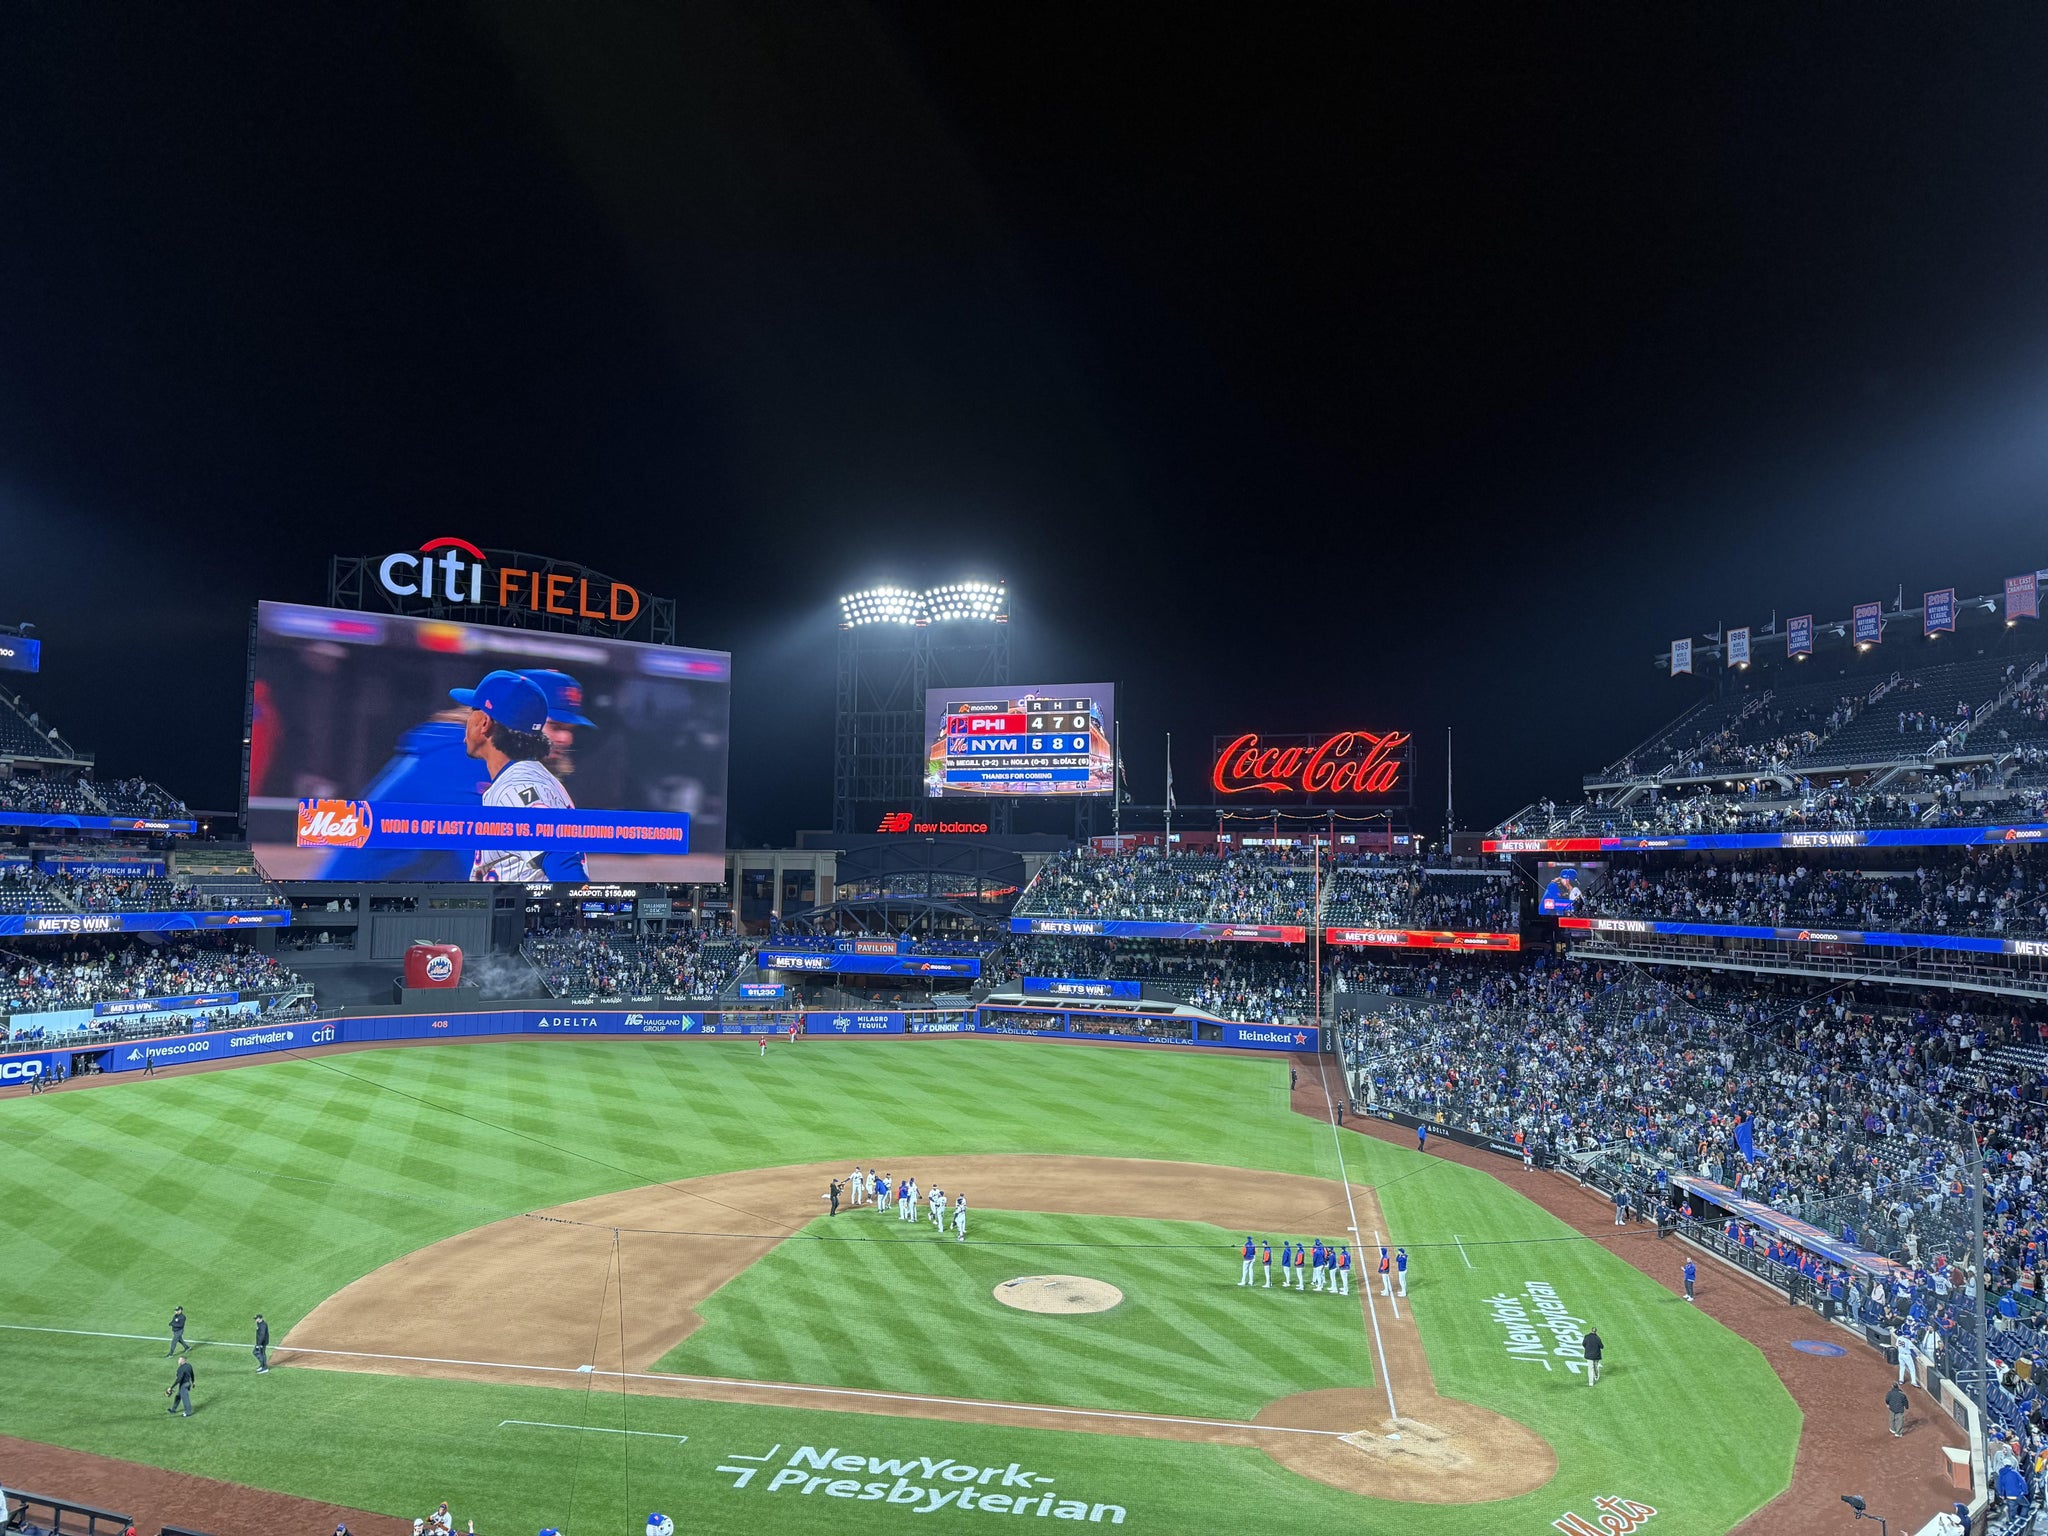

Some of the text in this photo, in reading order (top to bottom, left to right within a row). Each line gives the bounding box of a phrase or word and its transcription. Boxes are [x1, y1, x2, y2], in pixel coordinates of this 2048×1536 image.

[380, 549, 640, 622] citi FIELD
[1928, 593, 1950, 606] 2015
[1856, 606, 1877, 618] 2000
[1927, 617, 1951, 626] CHAMPIONS
[1731, 631, 1745, 641] 1986
[1856, 629, 1878, 638] CHAMPIONS
[1674, 642, 1688, 651] 1969
[1033, 702, 1042, 711] R
[1054, 701, 1062, 710] H
[1076, 701, 1084, 709] E
[971, 719, 1006, 731] PHI
[1031, 716, 1085, 729] 4 7 0
[971, 738, 1017, 751] NYM
[1032, 737, 1085, 750] 5 8 0
[1213, 731, 1410, 793] Coca-Cola
[1025, 772, 1052, 780] COMING
[523, 790, 532, 803] 7
[300, 811, 358, 837] Mets
[380, 819, 683, 841] WON 6 OF LAST 7 GAMES VS. PHI (INCLUDING POSTSEASON)
[914, 823, 937, 833] new
[940, 821, 988, 833] balance
[1793, 834, 1854, 845] METS WIN
[2016, 830, 2041, 838] moomoo
[1502, 841, 1540, 850] METS WIN
[39, 918, 109, 930] METS WIN
[1040, 922, 1093, 932] METS WIN
[1598, 920, 1646, 932] METS WIN
[1345, 932, 1397, 942] METS WIN
[1809, 932, 1838, 940] moomoo
[839, 942, 852, 951] citi
[2015, 941, 2048, 956] METS
[776, 957, 822, 968] METS WIN
[1058, 984, 1103, 994] METS WIN
[110, 1003, 135, 1013] METS
[553, 1018, 597, 1027] DELTA
[311, 1025, 335, 1043] citi
[997, 1028, 1038, 1036] CADILLAC
[1238, 1030, 1292, 1043] Heineken
[230, 1030, 285, 1048] smartwater
[1148, 1037, 1193, 1045] CADILLAC
[146, 1040, 209, 1058] Invesco QQQ
[1433, 1124, 1450, 1136] DELTA
[1482, 1293, 1548, 1354] NewYork-
[1525, 1281, 1587, 1358] Presbyterian
[787, 1446, 1055, 1488] NewYork-
[767, 1468, 1127, 1524] Presbyterian
[1551, 1495, 1658, 1536] Mets
